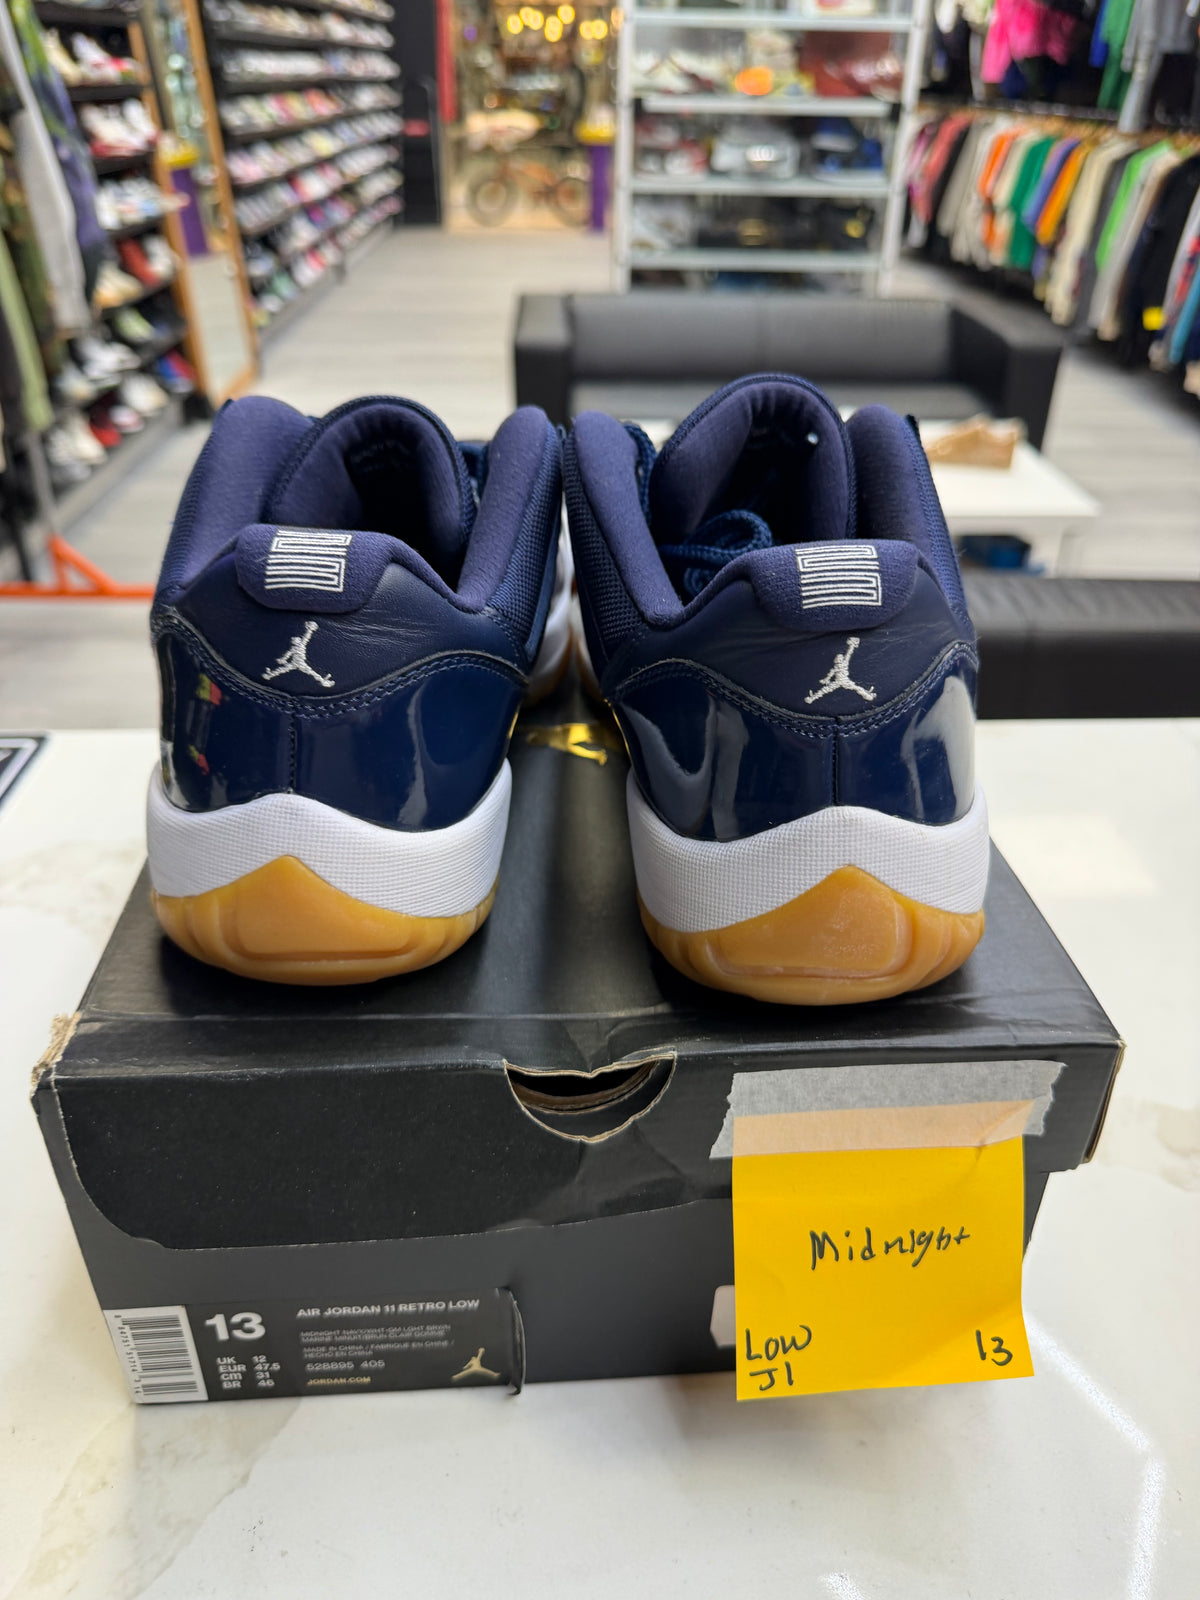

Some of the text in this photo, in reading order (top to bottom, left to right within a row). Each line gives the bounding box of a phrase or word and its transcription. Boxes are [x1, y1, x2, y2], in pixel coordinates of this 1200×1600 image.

[809, 1226, 970, 1270] Midnight
[296, 1299, 480, 1318] AIR JORDAN 11 RETRO LOW
[205, 1312, 266, 1341] 13
[301, 1329, 340, 1337] MIDNIGHT
[370, 1342, 410, 1351] FABRIQUE
[411, 1341, 424, 1349] EN
[976, 1329, 1013, 1366] 13
[216, 1354, 266, 1364] UK 12
[219, 1362, 280, 1373] EUR 47.5
[360, 1360, 385, 1369] 405
[256, 1371, 270, 1379] 31
[222, 1381, 241, 1389] BR
[307, 1376, 371, 1386] JORDAN.COM
